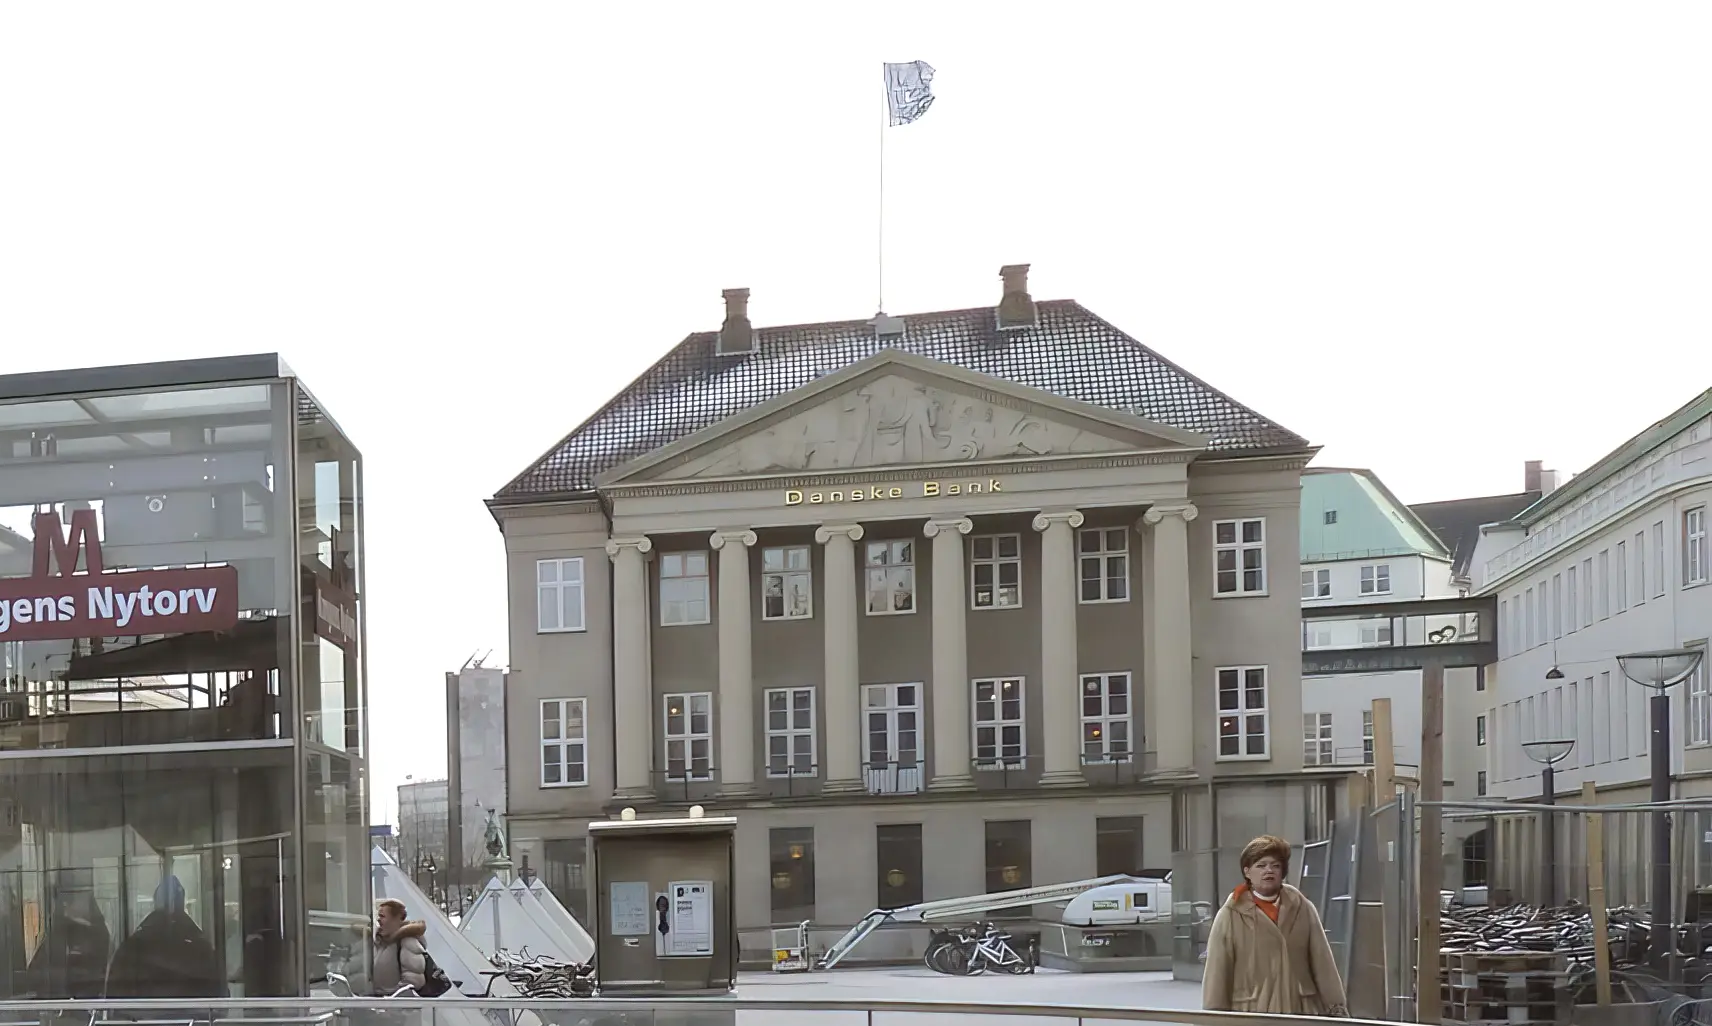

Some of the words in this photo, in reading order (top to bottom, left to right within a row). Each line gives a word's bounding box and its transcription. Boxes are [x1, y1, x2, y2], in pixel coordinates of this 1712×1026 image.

[785, 485, 902, 506] Danske
[923, 479, 1002, 497] Bank
[31, 509, 104, 578] M
[87, 584, 218, 627] Nytorv
